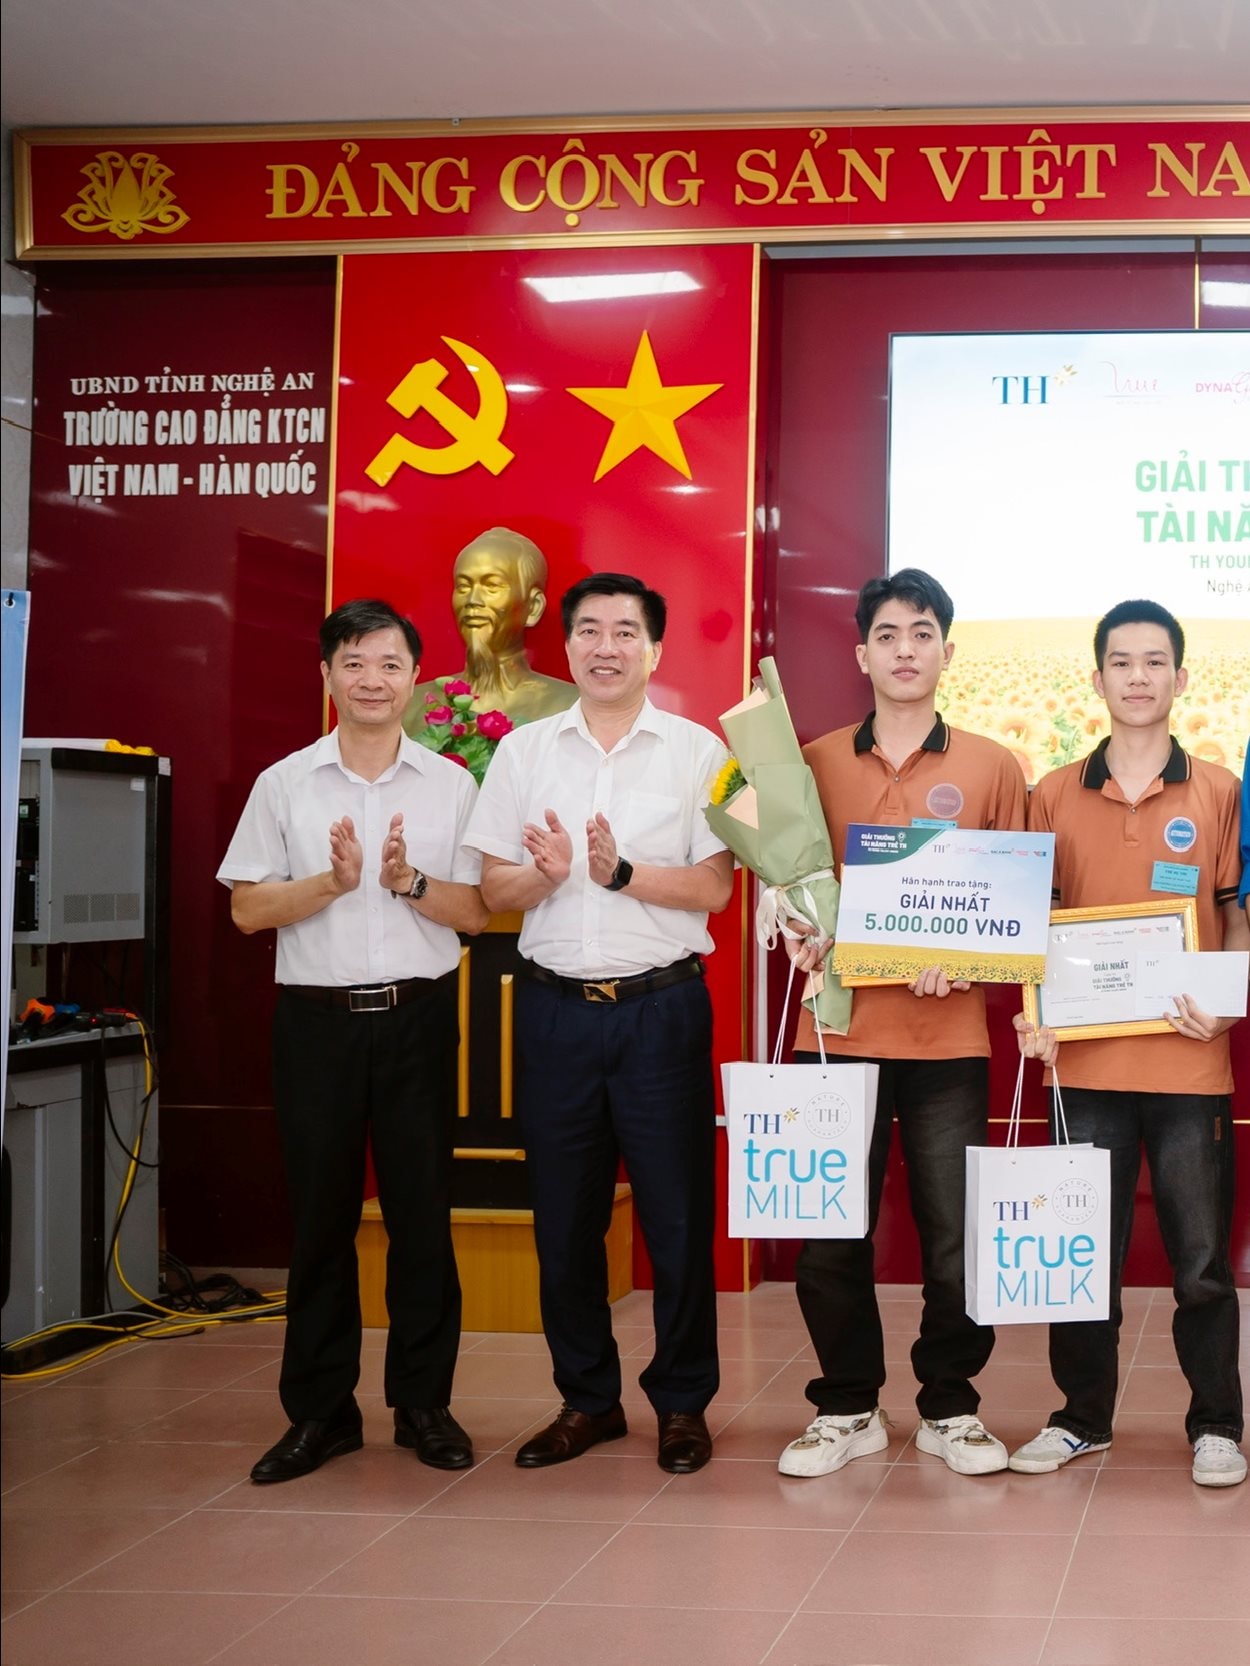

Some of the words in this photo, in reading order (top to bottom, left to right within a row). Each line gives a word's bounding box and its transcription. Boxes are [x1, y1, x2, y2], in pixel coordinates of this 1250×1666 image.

[265, 142, 472, 219] ĐẢNG
[500, 139, 703, 227] CỘNG
[735, 128, 894, 206] SẢN
[919, 129, 1116, 215] VIỆT
[70, 376, 139, 395] UBND
[145, 366, 206, 393] TỈNH
[211, 366, 275, 397] NGHỆ
[281, 372, 315, 390] AN
[992, 375, 1050, 404] TH
[64, 401, 148, 446] TRƯỜNG
[155, 409, 197, 445] CAO
[204, 393, 261, 445] ĐẲNG
[267, 408, 325, 443] KTCN
[68, 456, 118, 504] VIỆT
[124, 464, 179, 496] NAM
[199, 454, 250, 495] HÀN
[255, 449, 317, 498] QUỐC
[1135, 449, 1207, 492] GIẢI
[1136, 502, 1195, 543] TÀI
[1189, 555, 1210, 568] TH
[900, 890, 935, 910] GIẢI
[941, 891, 990, 912] NHẤT
[947, 879, 966, 888] trao
[865, 913, 968, 935] 5.000.000
[976, 918, 1021, 937] VNĐ
[744, 1113, 782, 1134] TH
[743, 1139, 848, 1183] true
[746, 1184, 847, 1220] MILK
[993, 1201, 1029, 1221] TH
[993, 1226, 1095, 1269] true
[997, 1268, 1095, 1307] MILK
